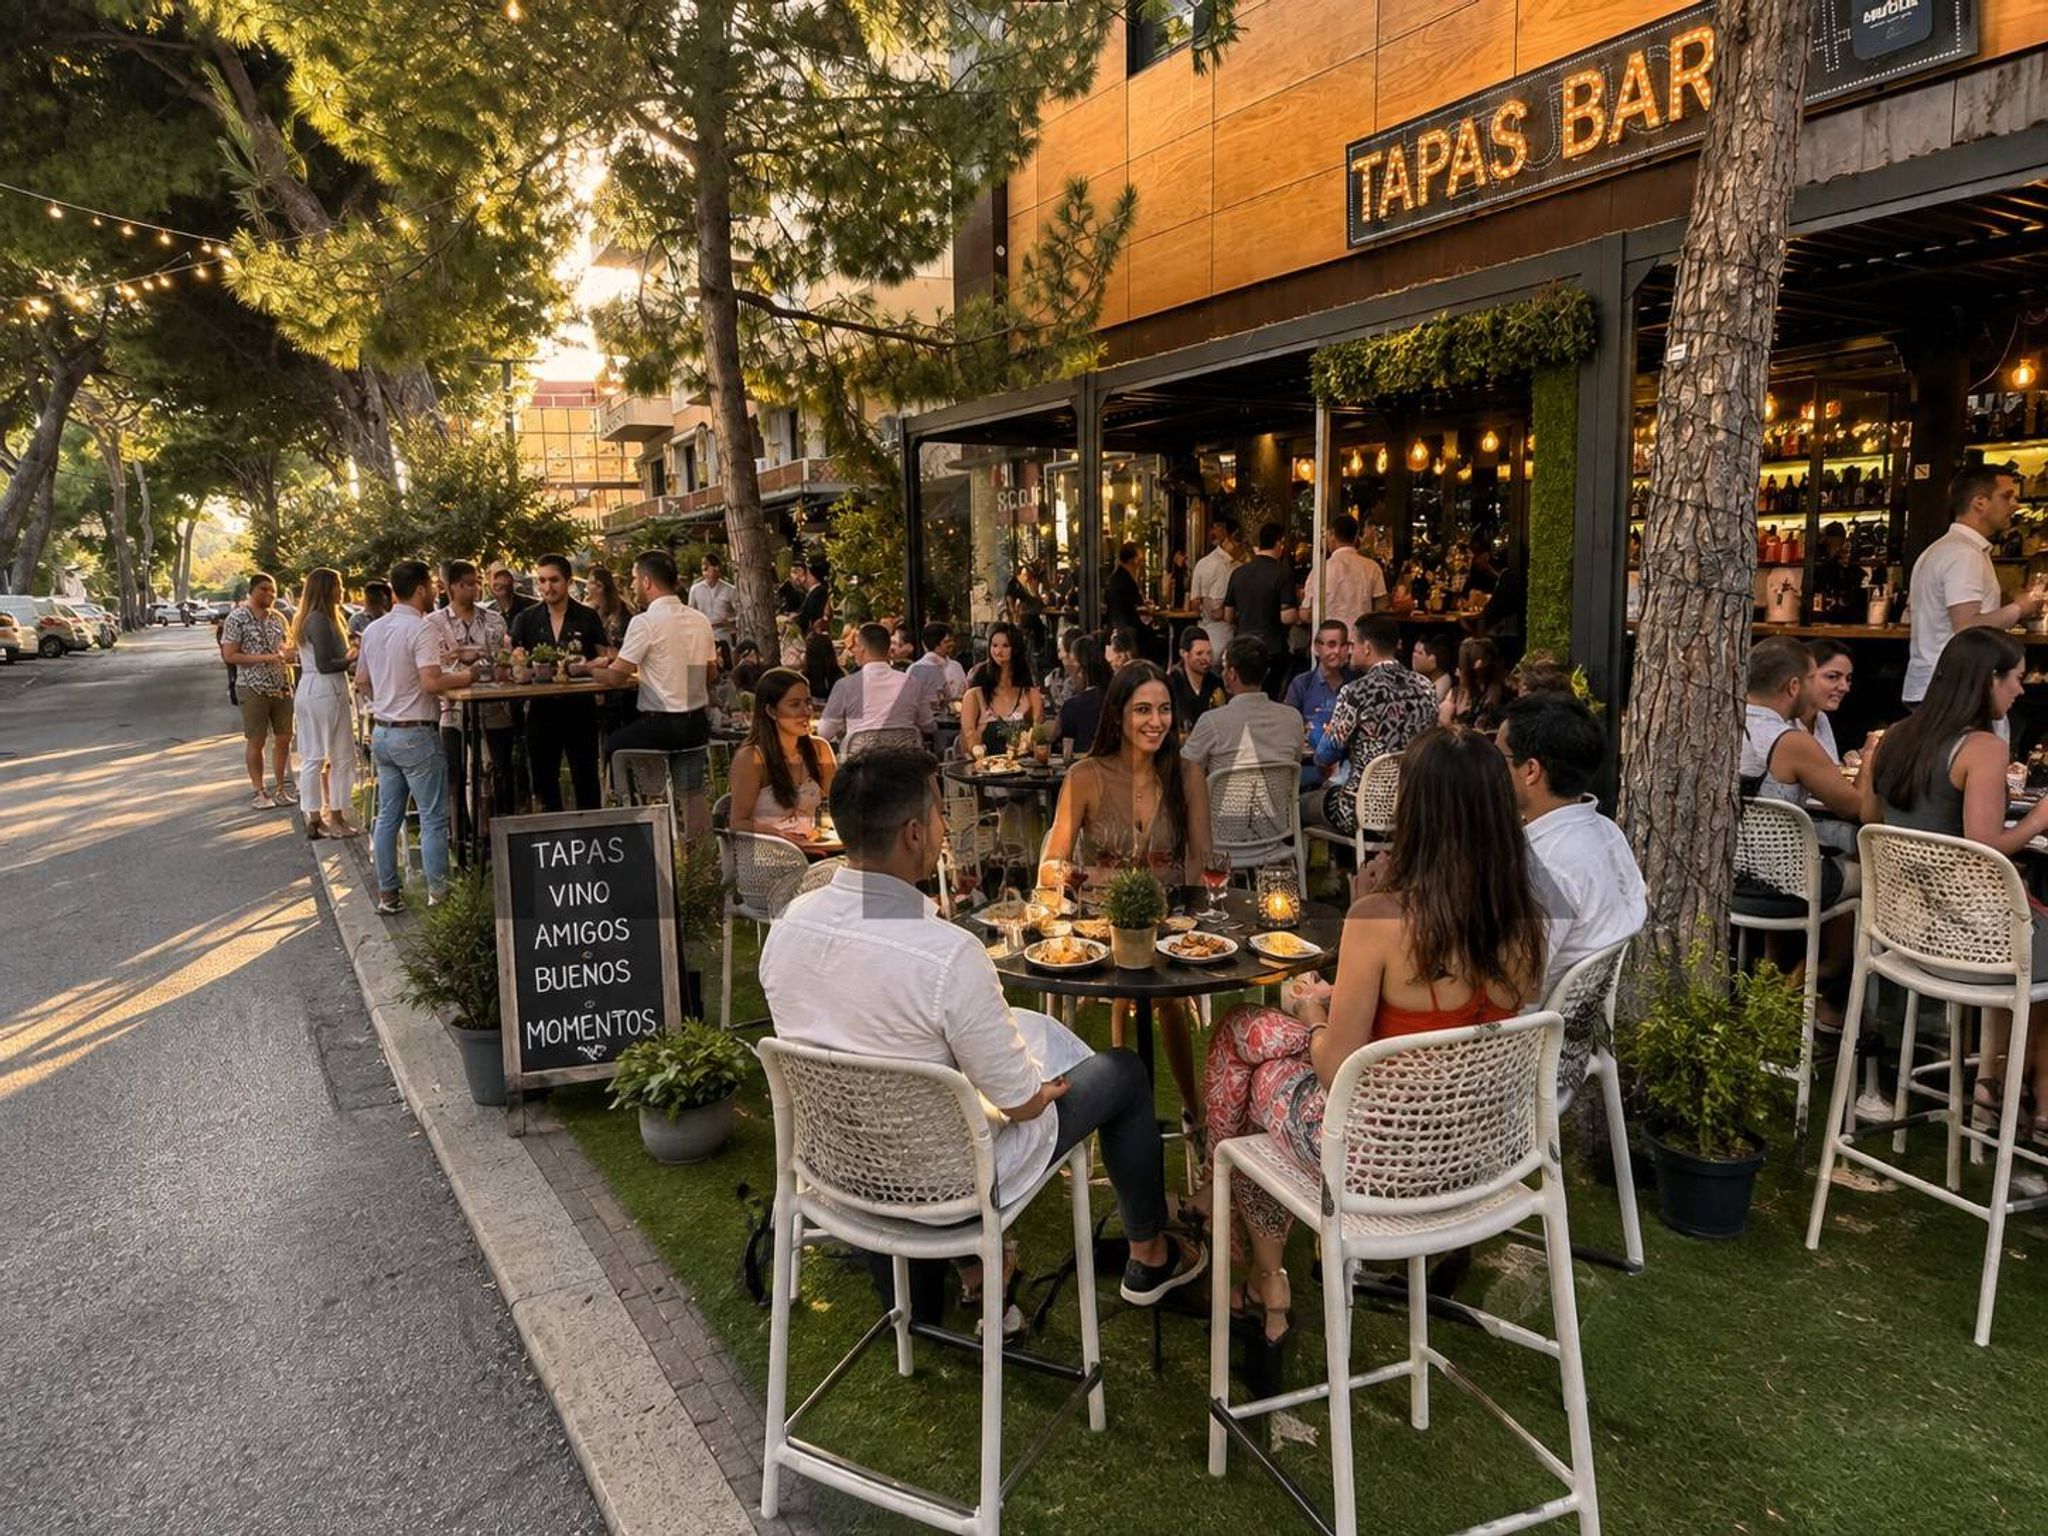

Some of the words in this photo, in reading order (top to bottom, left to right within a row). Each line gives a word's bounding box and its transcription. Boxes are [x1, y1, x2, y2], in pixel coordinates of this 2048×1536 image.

[1351, 99, 1528, 223] TAPAS
[1561, 26, 1716, 161] BAR
[531, 836, 625, 869] TAPAS
[549, 880, 611, 907] VINO
[534, 918, 631, 950] AMIGOS
[535, 959, 632, 993] BUENOS
[526, 1008, 657, 1050] MOMENTOS
